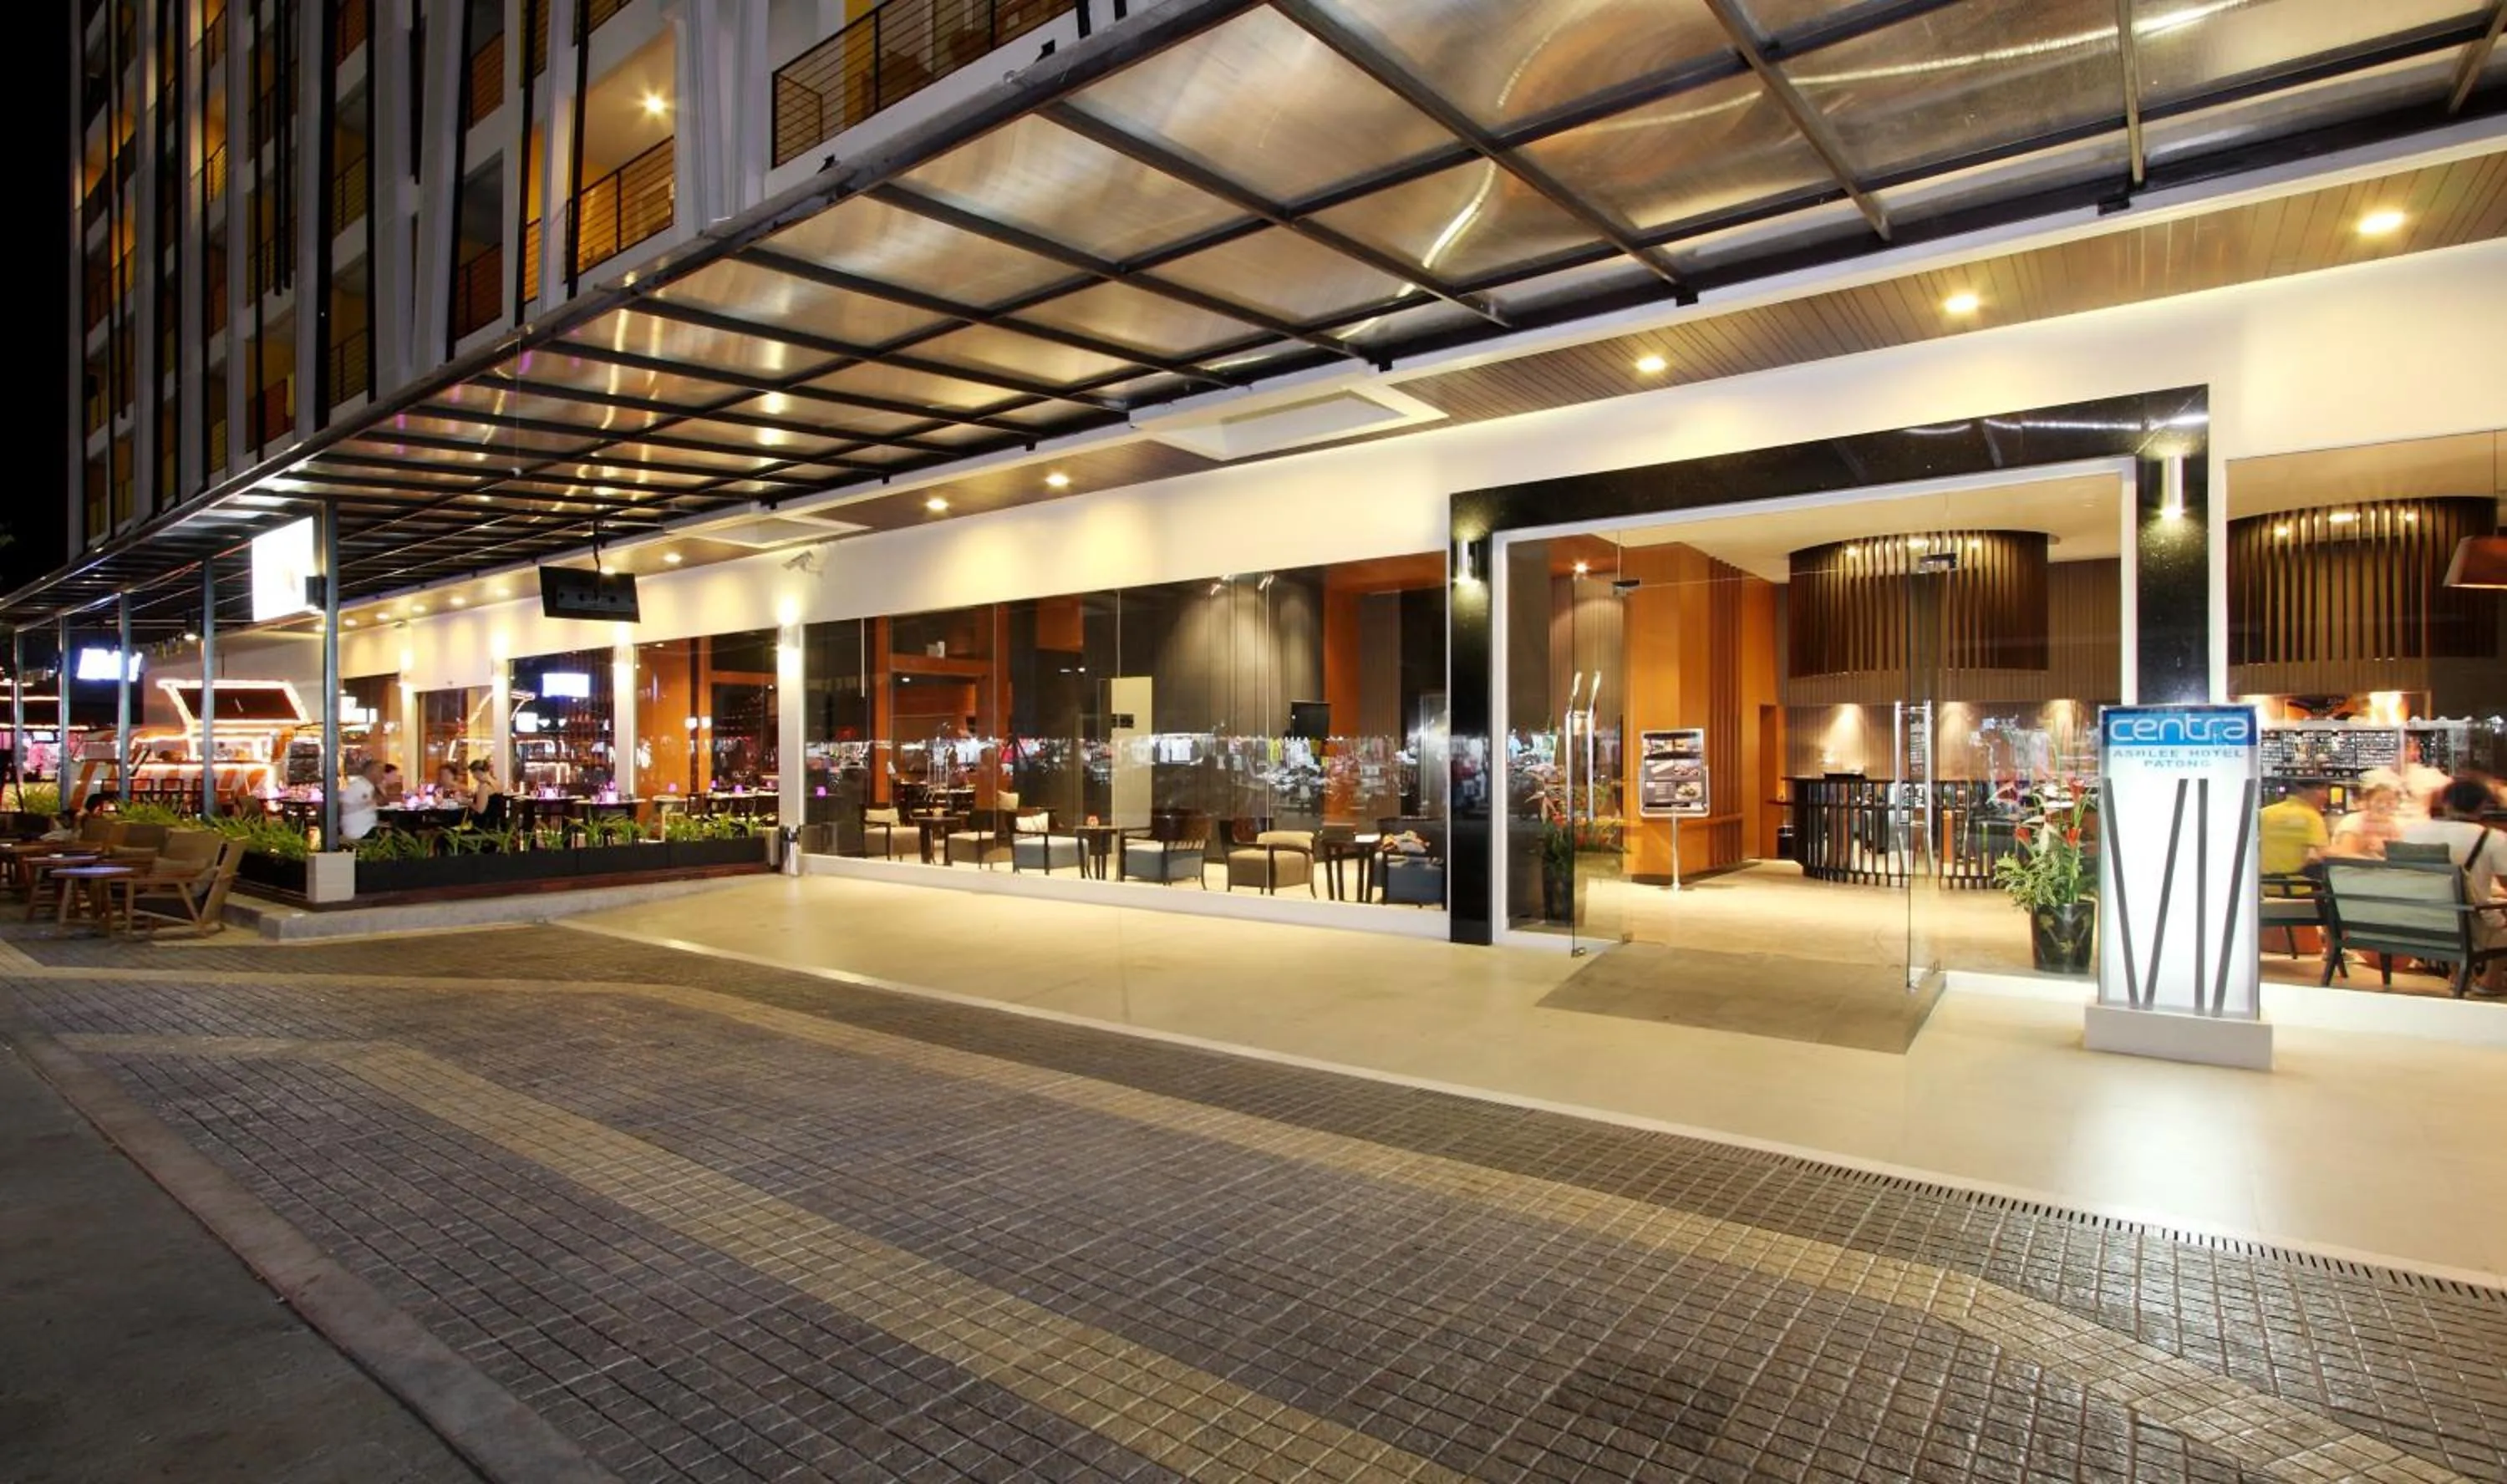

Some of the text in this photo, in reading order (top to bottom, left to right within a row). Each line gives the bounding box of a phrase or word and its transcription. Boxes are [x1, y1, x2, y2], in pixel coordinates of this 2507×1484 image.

[2110, 713, 2248, 741] centra
[2113, 749, 2245, 758] ASHLEE HOTEL
[2143, 760, 2212, 768] PATONG
